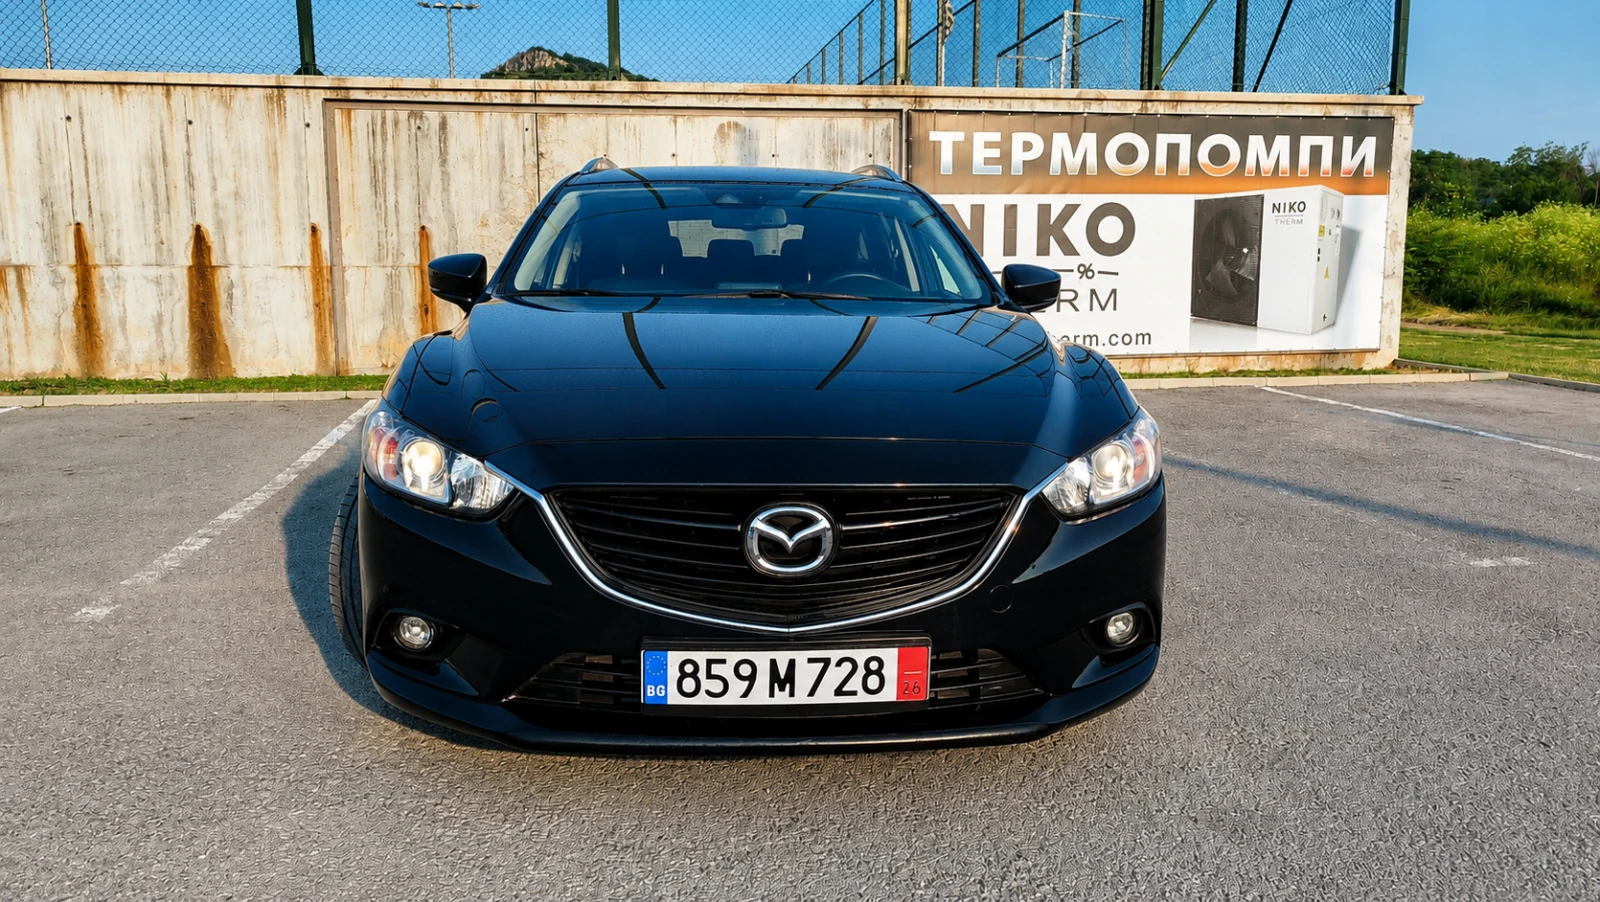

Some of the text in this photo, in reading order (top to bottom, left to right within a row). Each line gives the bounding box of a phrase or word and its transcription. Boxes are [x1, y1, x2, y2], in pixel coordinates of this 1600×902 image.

[929, 131, 1376, 177] ТЕРМОПОМПИ
[1271, 200, 1306, 214] NIKO
[1036, 288, 1117, 313] RM
[647, 685, 665, 697] BG
[903, 681, 921, 695] 26
